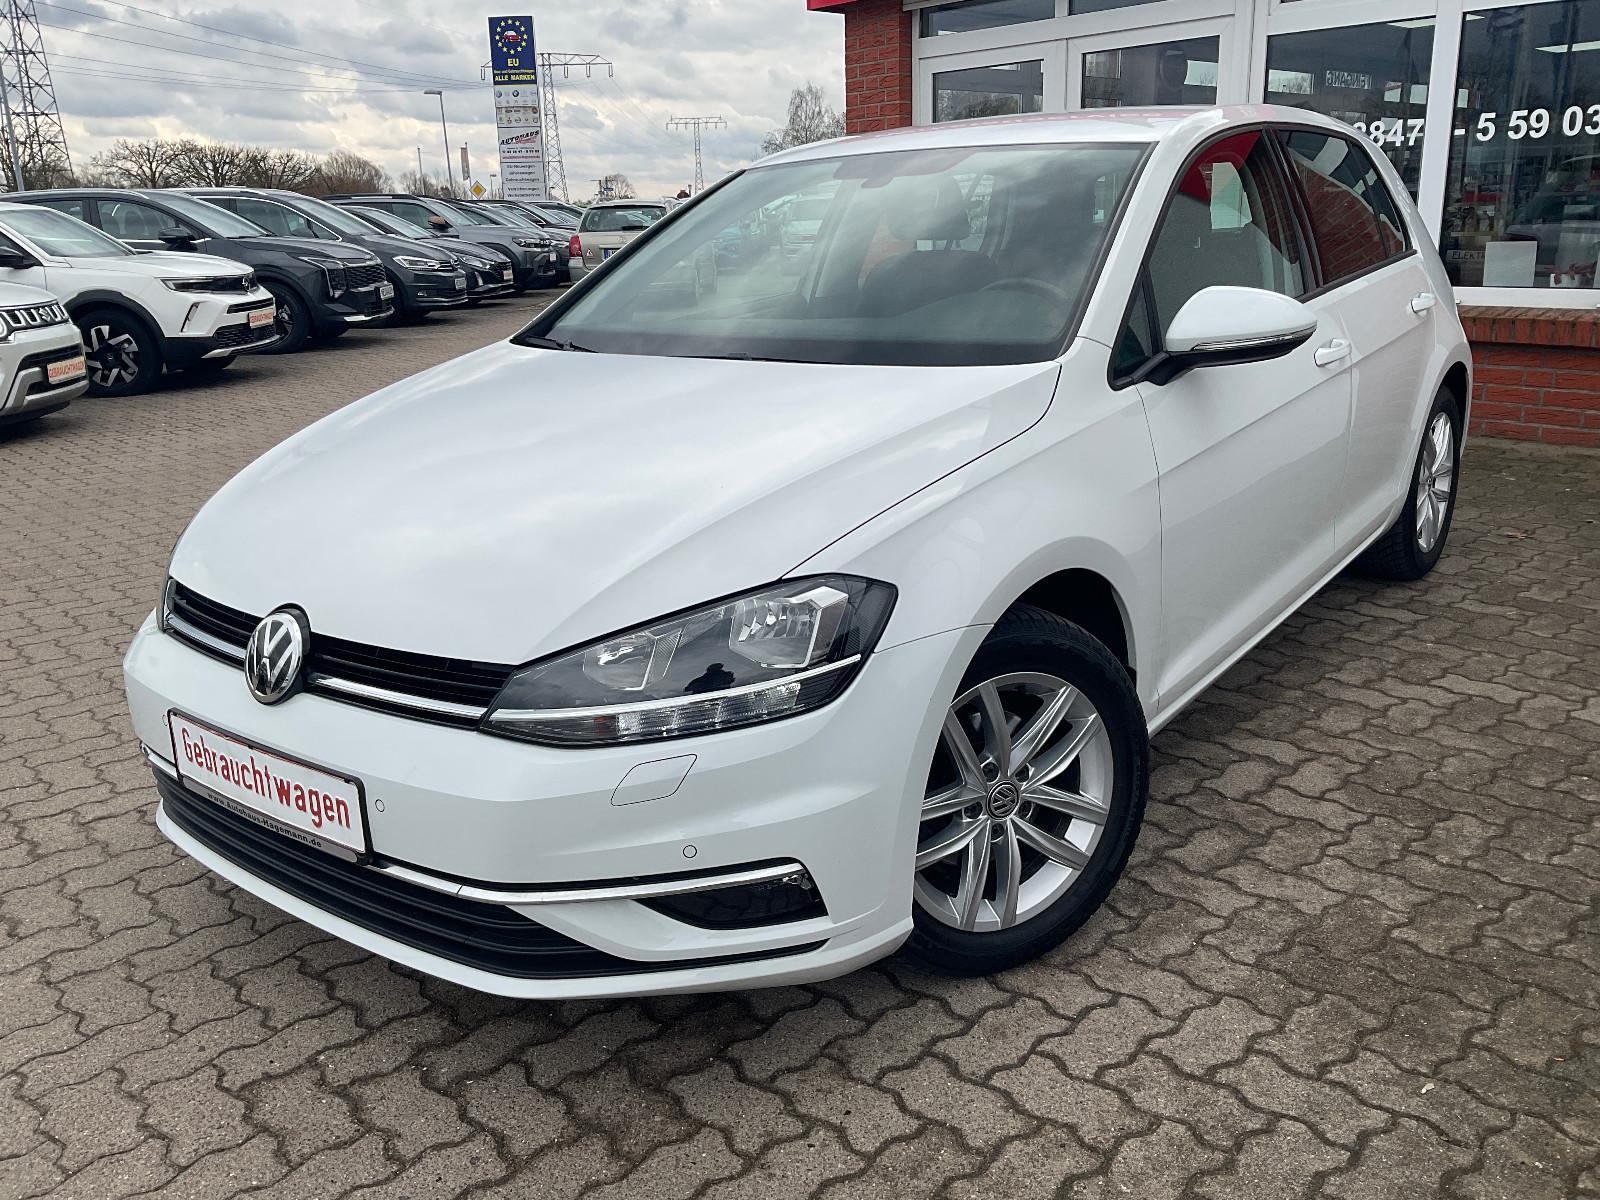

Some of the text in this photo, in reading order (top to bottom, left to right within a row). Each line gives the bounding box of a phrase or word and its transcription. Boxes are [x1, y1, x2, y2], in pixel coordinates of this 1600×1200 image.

[1476, 112, 1497, 142] 5
[1507, 108, 1550, 140] 59
[1562, 104, 1600, 137] 03
[181, 727, 351, 830] Gebrauchtwagen
[207, 791, 322, 849] www.Autohaus-Hagemann.de
